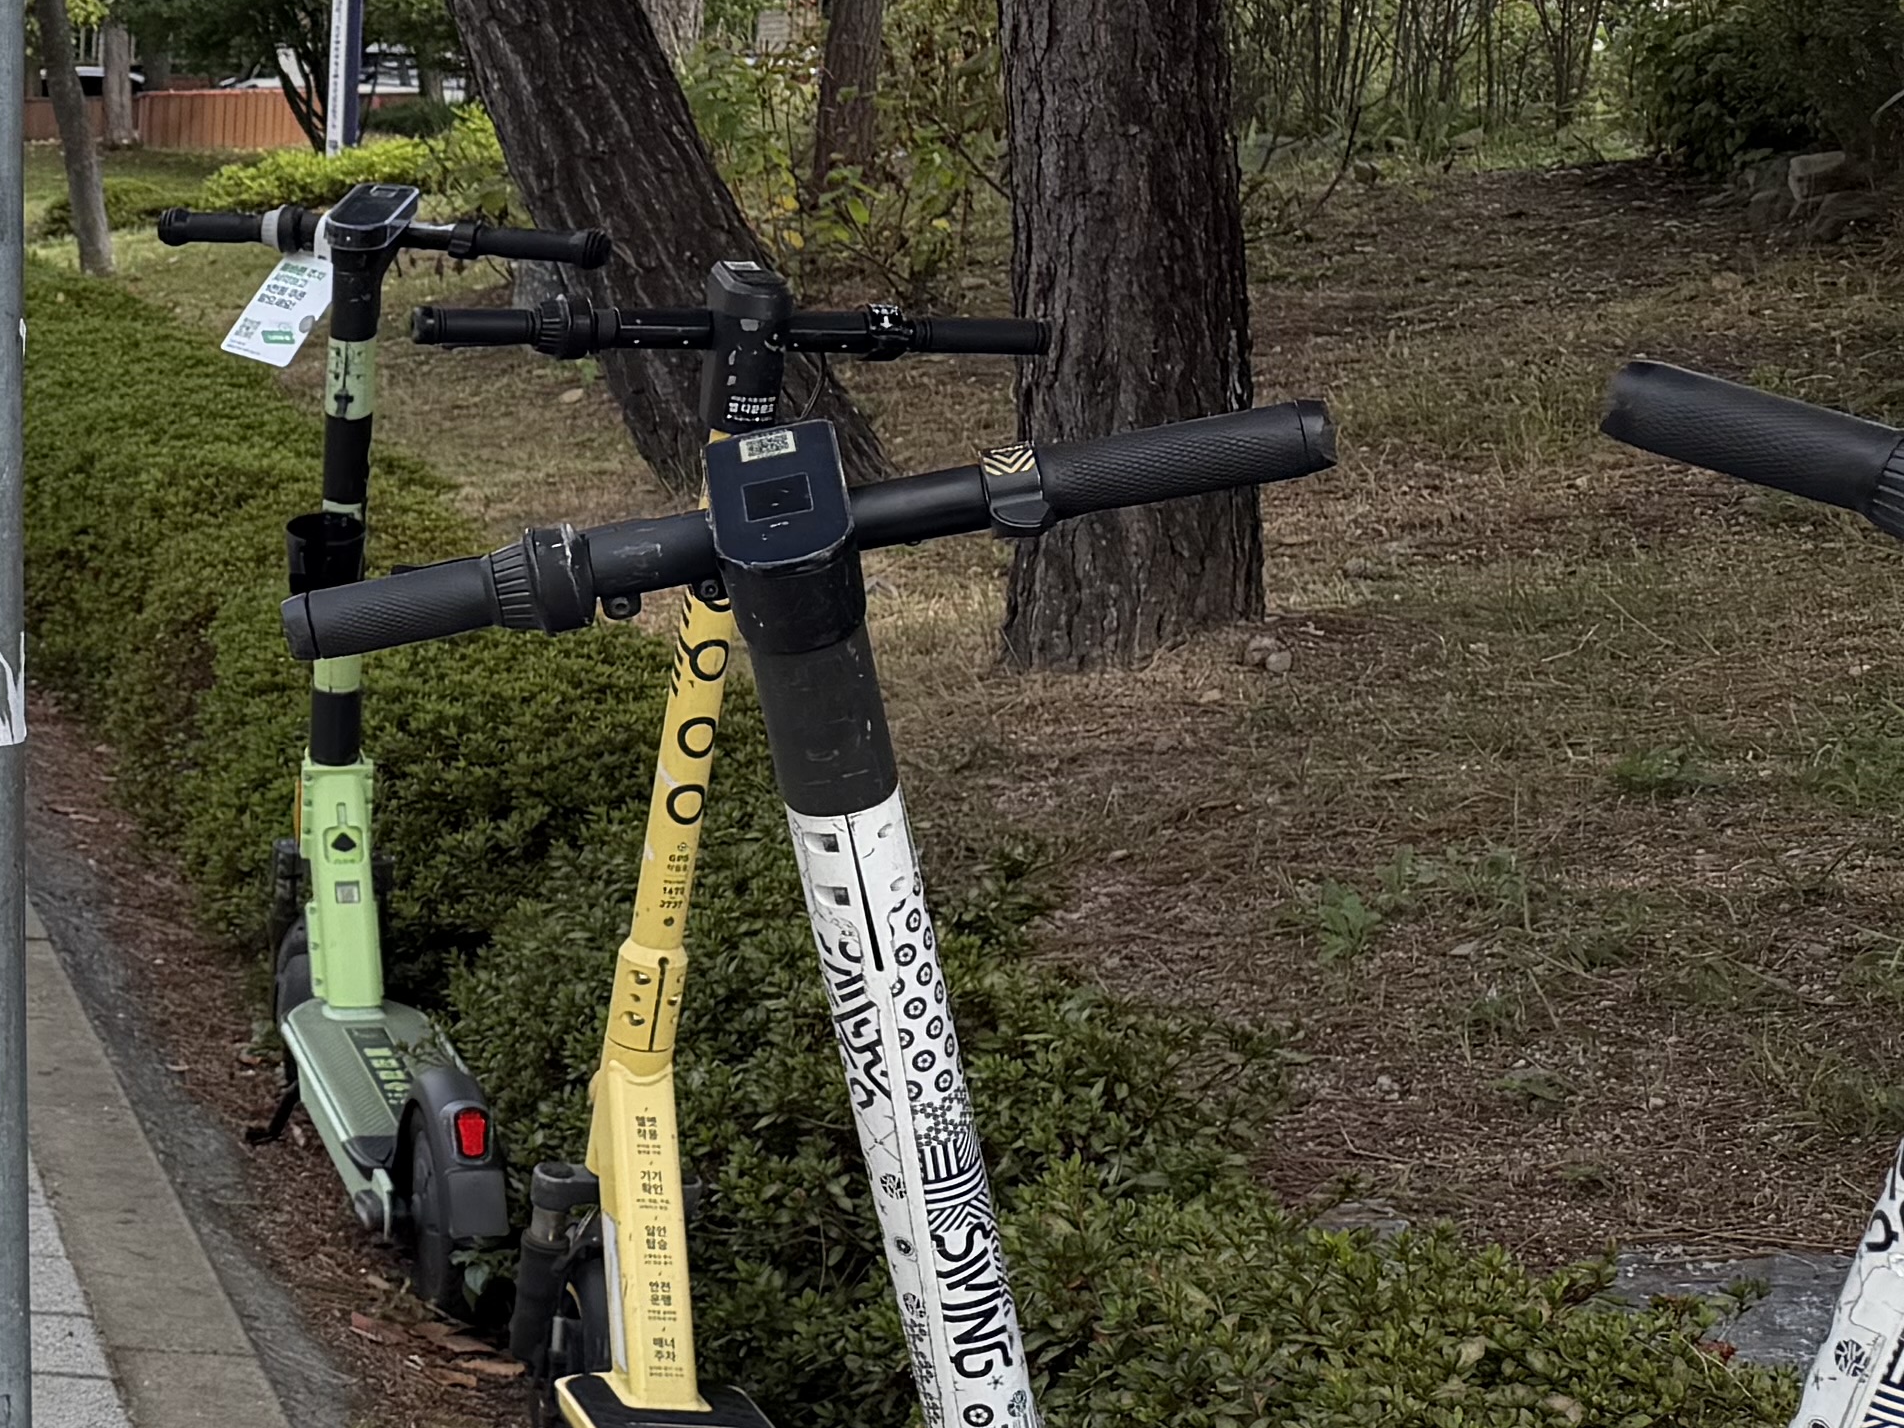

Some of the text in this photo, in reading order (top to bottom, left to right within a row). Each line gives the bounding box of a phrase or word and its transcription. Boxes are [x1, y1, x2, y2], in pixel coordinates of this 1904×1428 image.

[640, 1170, 662, 1182] 기기
[649, 1281, 671, 1293] 안전
[652, 1336, 676, 1350] 매너
[654, 1350, 677, 1362] 주차
